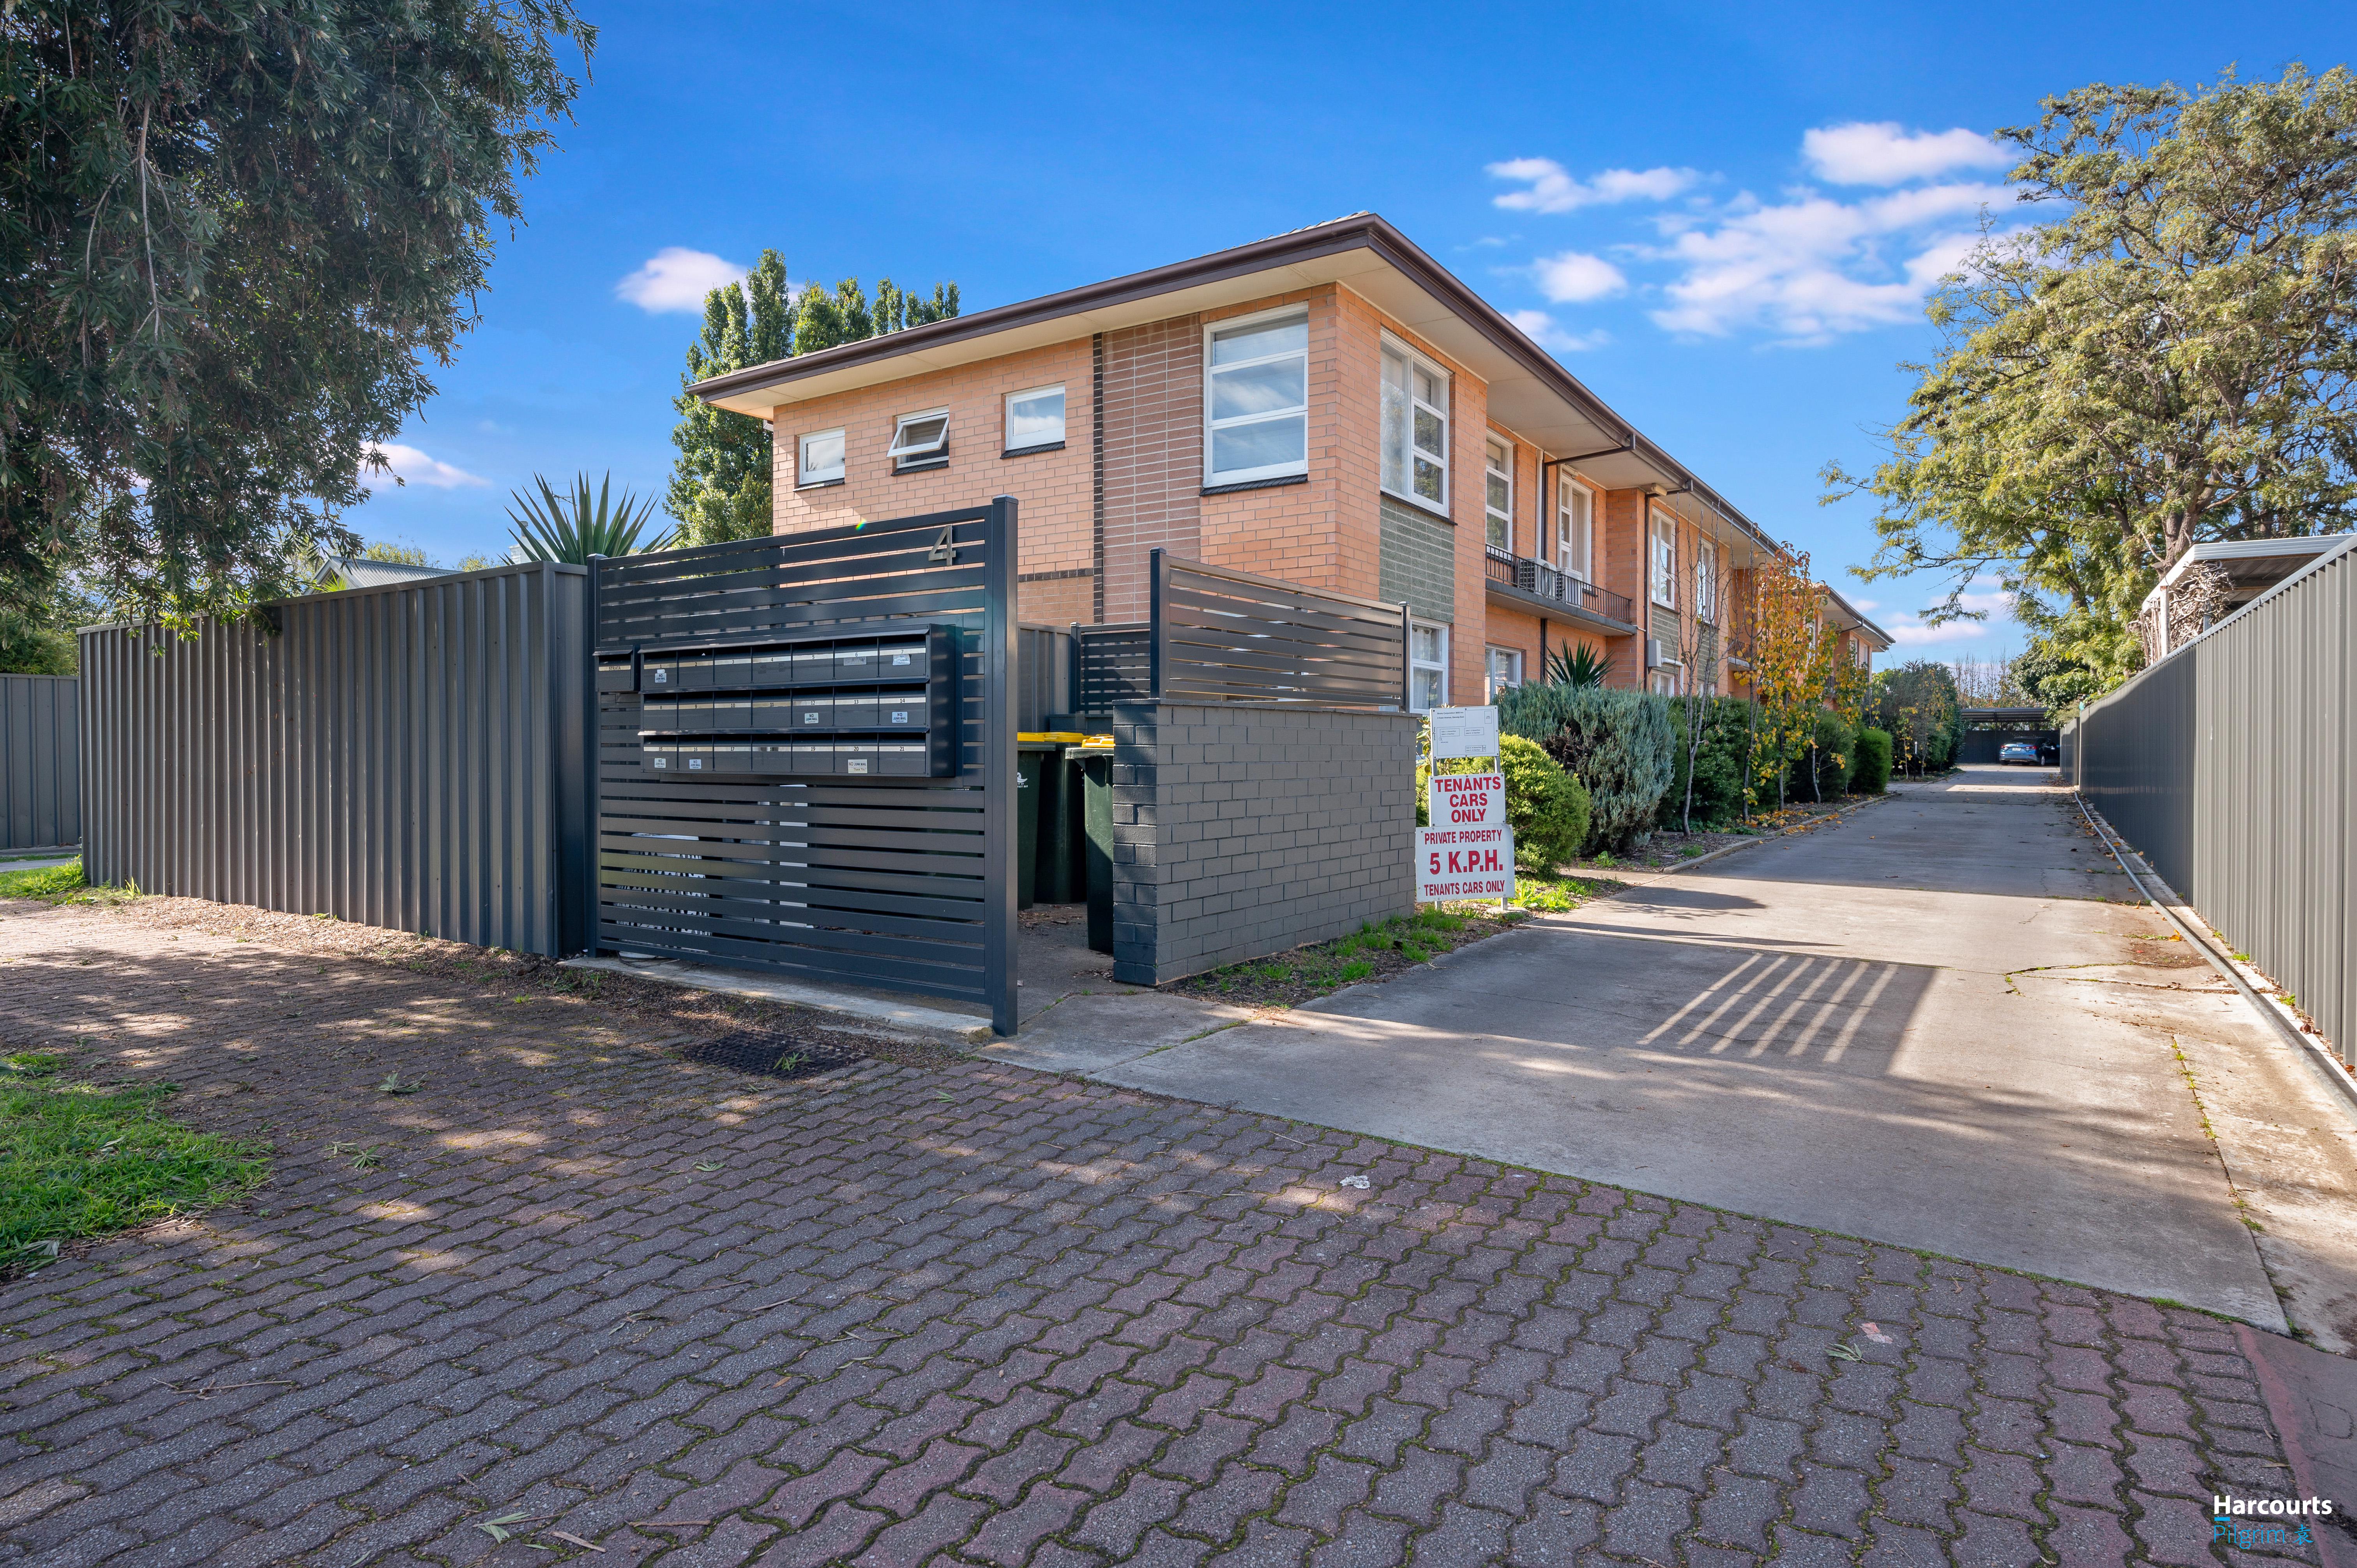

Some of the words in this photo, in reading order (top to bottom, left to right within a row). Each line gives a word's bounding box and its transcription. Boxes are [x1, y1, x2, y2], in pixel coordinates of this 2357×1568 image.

[928, 525, 956, 566] 4
[1435, 776, 1501, 792] TENANTS
[1450, 793, 1488, 807] CARS
[1451, 808, 1486, 823] ONLY
[1424, 832, 1456, 845] PRIVATE
[1459, 830, 1502, 843] PROPERTY
[1429, 853, 1440, 875] 5
[1448, 849, 1503, 874] K.P.H.
[1424, 883, 1459, 896] TENANTS
[1463, 881, 1483, 894] CARS
[1486, 880, 1505, 892] ONLY
